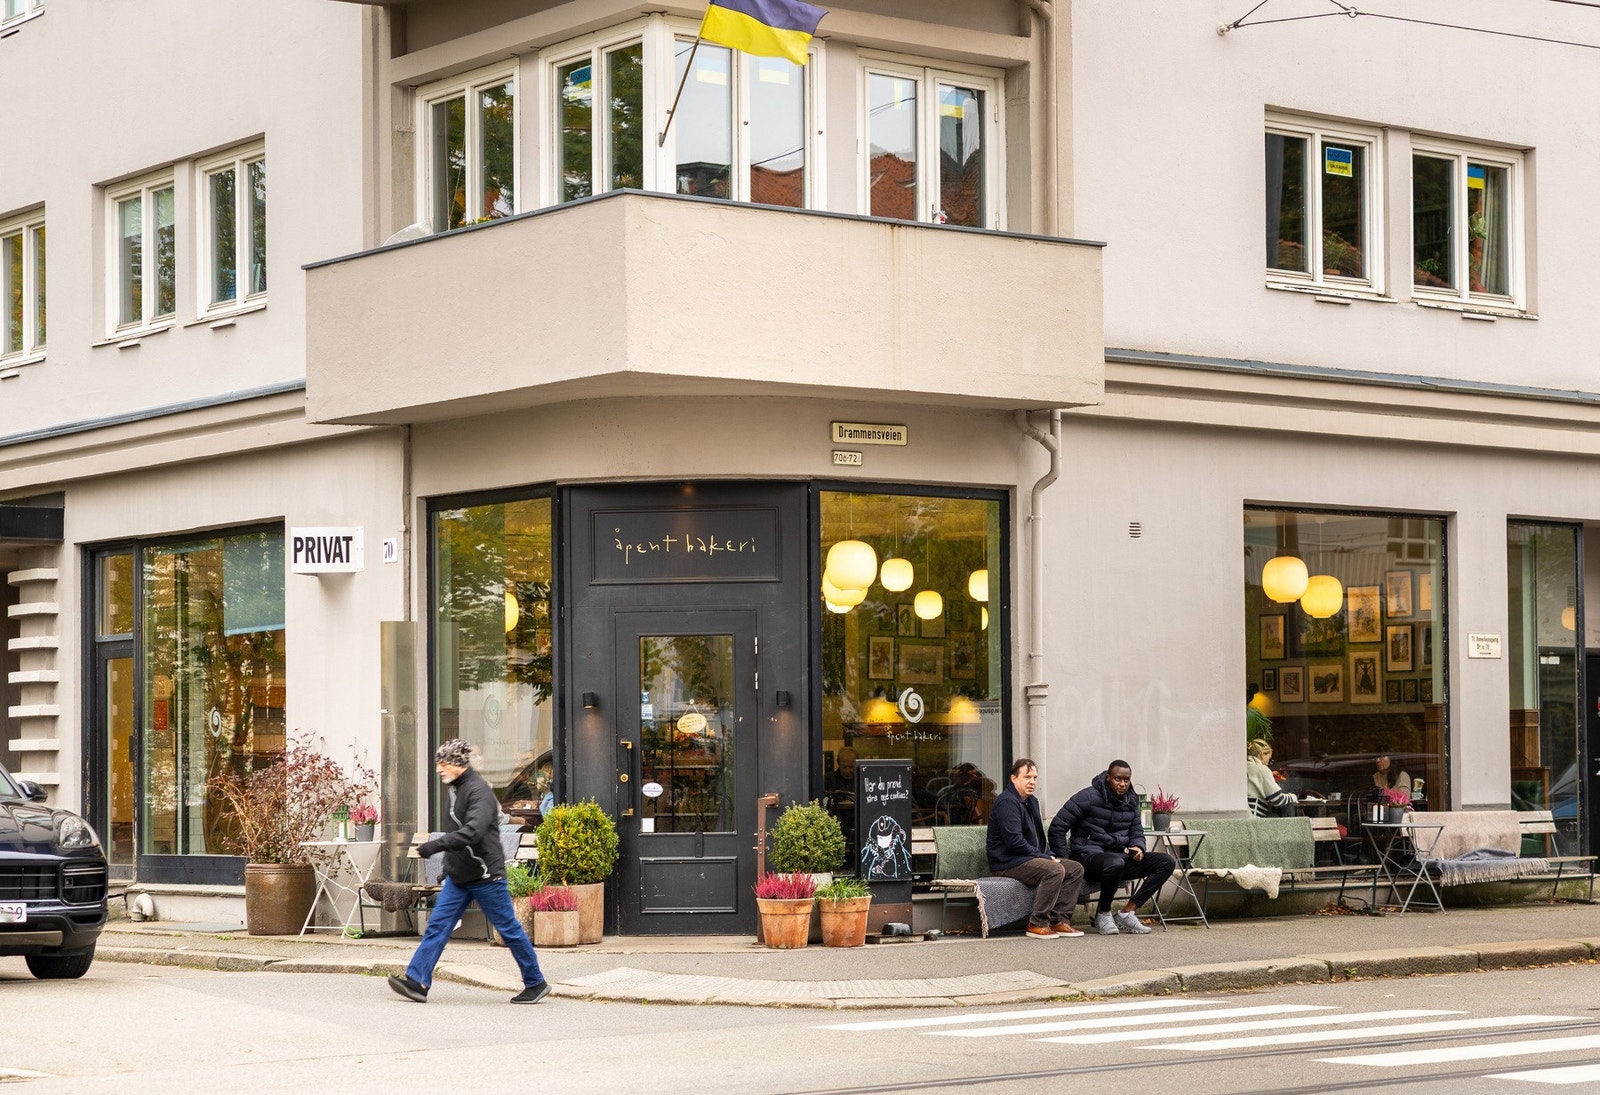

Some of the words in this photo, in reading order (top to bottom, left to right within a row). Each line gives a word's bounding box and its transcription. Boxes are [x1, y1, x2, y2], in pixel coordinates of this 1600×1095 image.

[838, 425, 902, 441] Drammensveien
[293, 536, 353, 564] PRIVAT
[383, 541, 394, 559] 70
[614, 527, 677, 565] åpent
[686, 533, 756, 556] bakeri
[864, 777, 876, 793] Har
